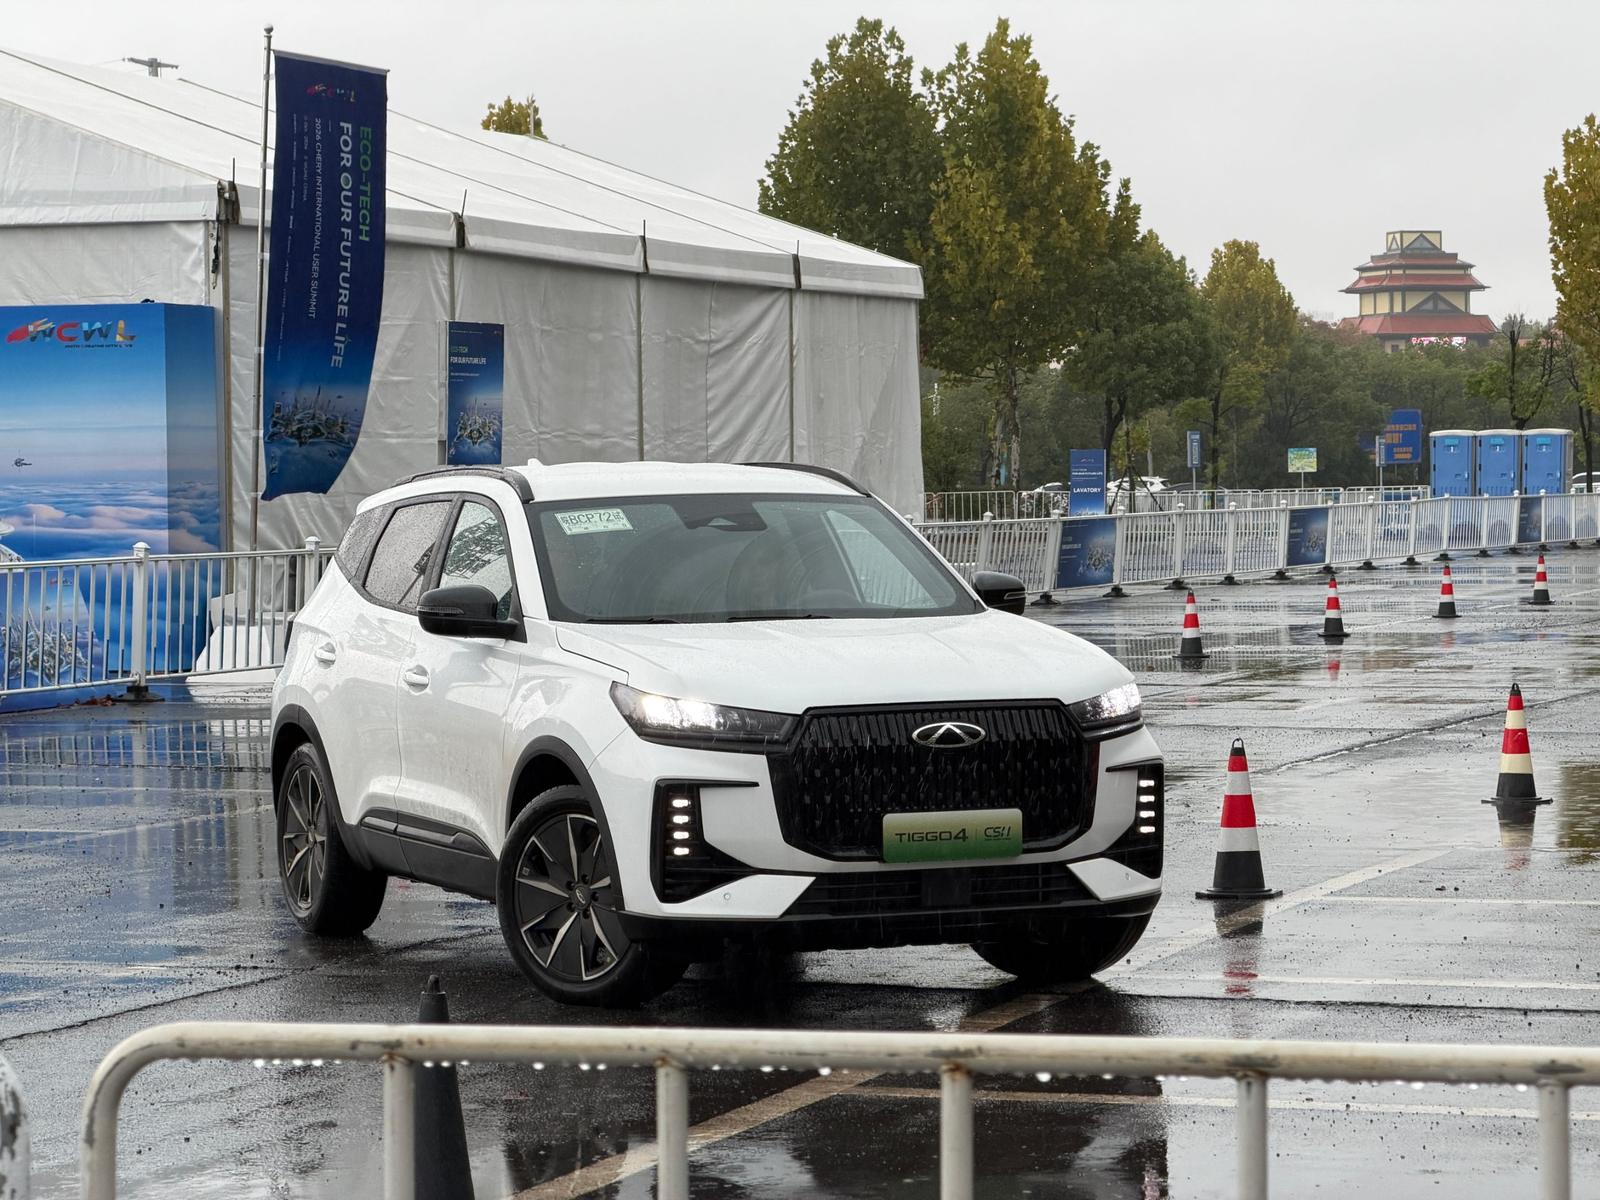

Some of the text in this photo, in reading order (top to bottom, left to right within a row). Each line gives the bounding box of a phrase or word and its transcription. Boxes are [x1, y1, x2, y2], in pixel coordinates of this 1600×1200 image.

[359, 127, 371, 241] ECO-TECH
[313, 176, 322, 251] INTERNATIONAL
[312, 253, 320, 278] USER
[331, 122, 352, 368] FOR OUR FUTURE LIFE
[308, 280, 318, 319] SUMMIT
[7, 318, 136, 342] WCWL
